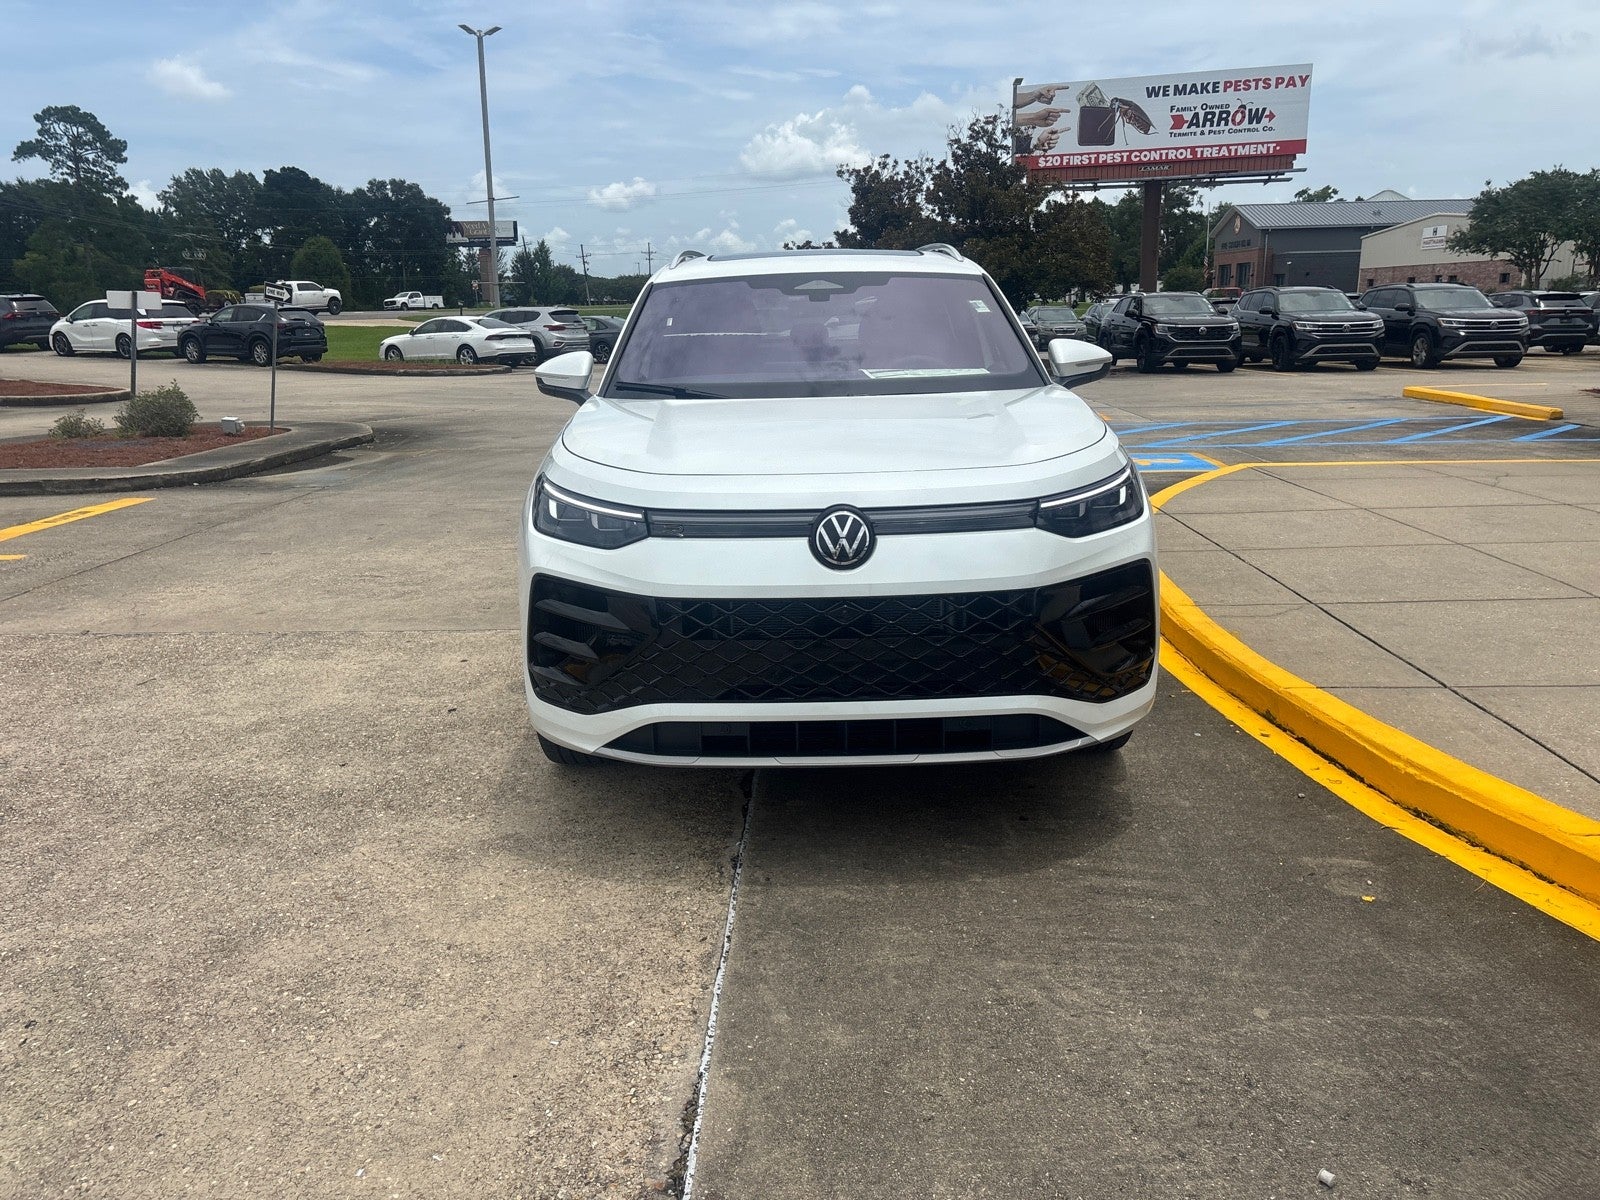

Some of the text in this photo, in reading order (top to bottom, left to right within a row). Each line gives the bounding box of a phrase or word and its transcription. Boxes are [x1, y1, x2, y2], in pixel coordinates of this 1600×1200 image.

[1145, 74, 1310, 98] WE MAKE PESTS PAY
[1169, 103, 1230, 113] FAMILY OWNED
[1186, 106, 1268, 129] ARROW
[1227, 126, 1260, 134] CONTROL
[1038, 155, 1061, 168] $20
[1062, 153, 1097, 166] FIRST
[1099, 152, 1129, 164] PEST
[1131, 148, 1193, 162] CONTROL
[818, 513, 867, 562] VW
